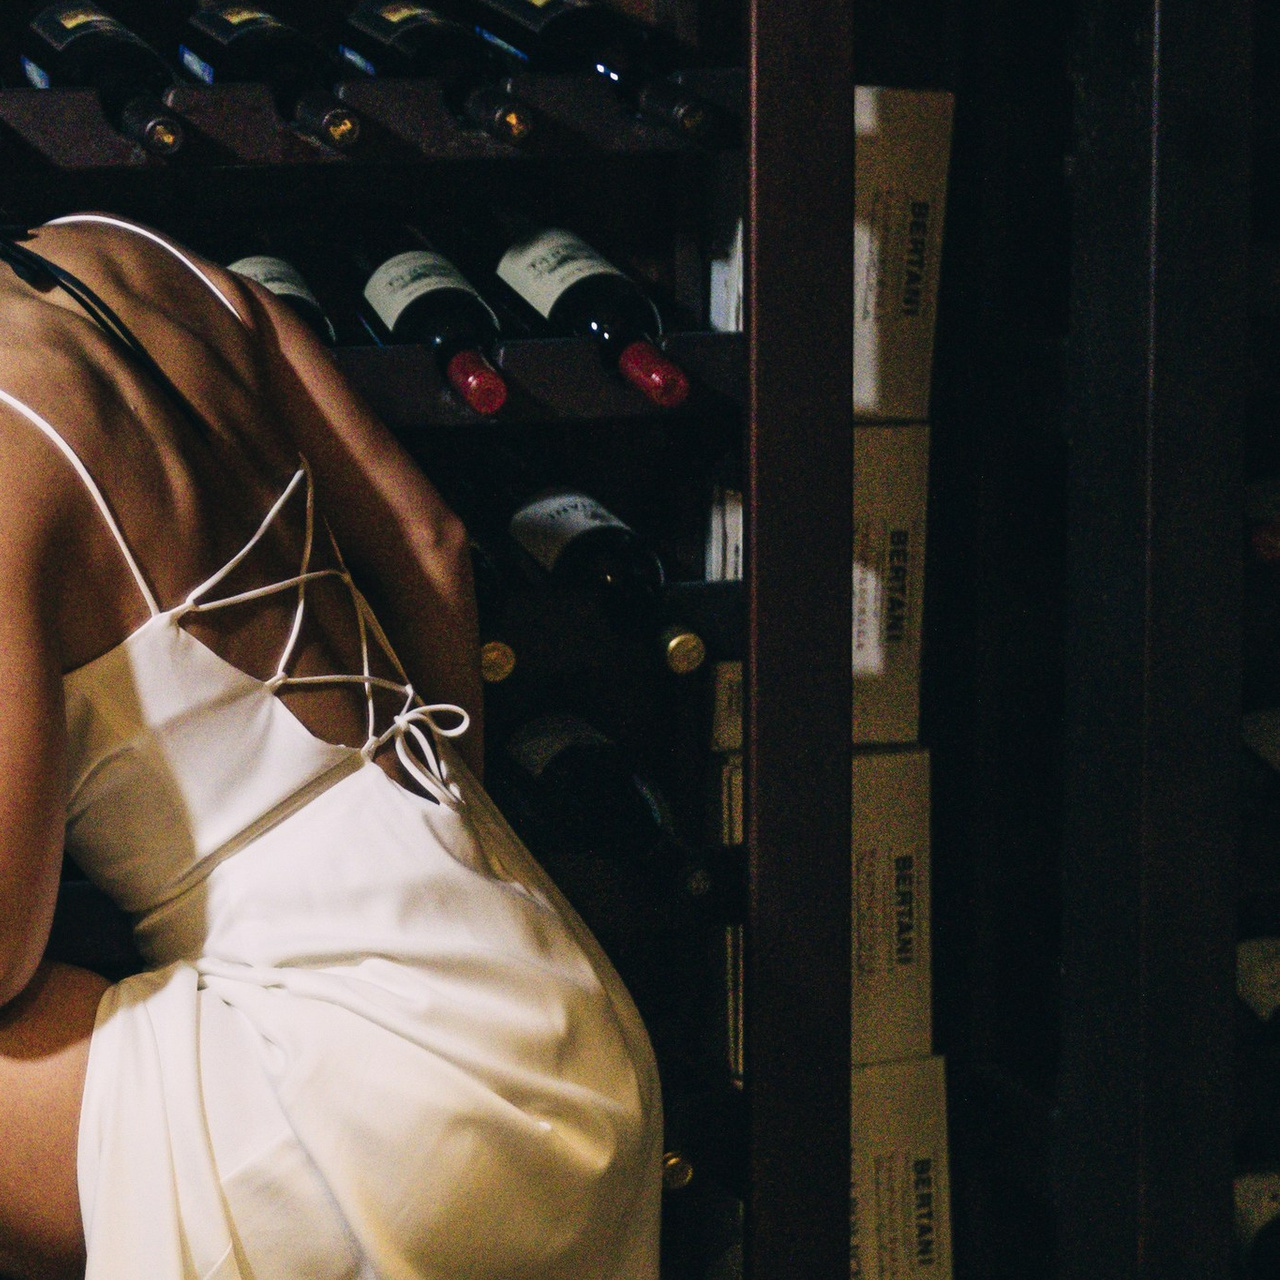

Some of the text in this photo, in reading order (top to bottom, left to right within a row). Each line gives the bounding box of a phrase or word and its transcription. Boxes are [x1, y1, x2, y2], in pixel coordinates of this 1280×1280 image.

[903, 201, 931, 318] BERTANI
[887, 529, 908, 642] BERTANI
[894, 854, 915, 966] BERTANI
[913, 1157, 935, 1266] BERTANI
